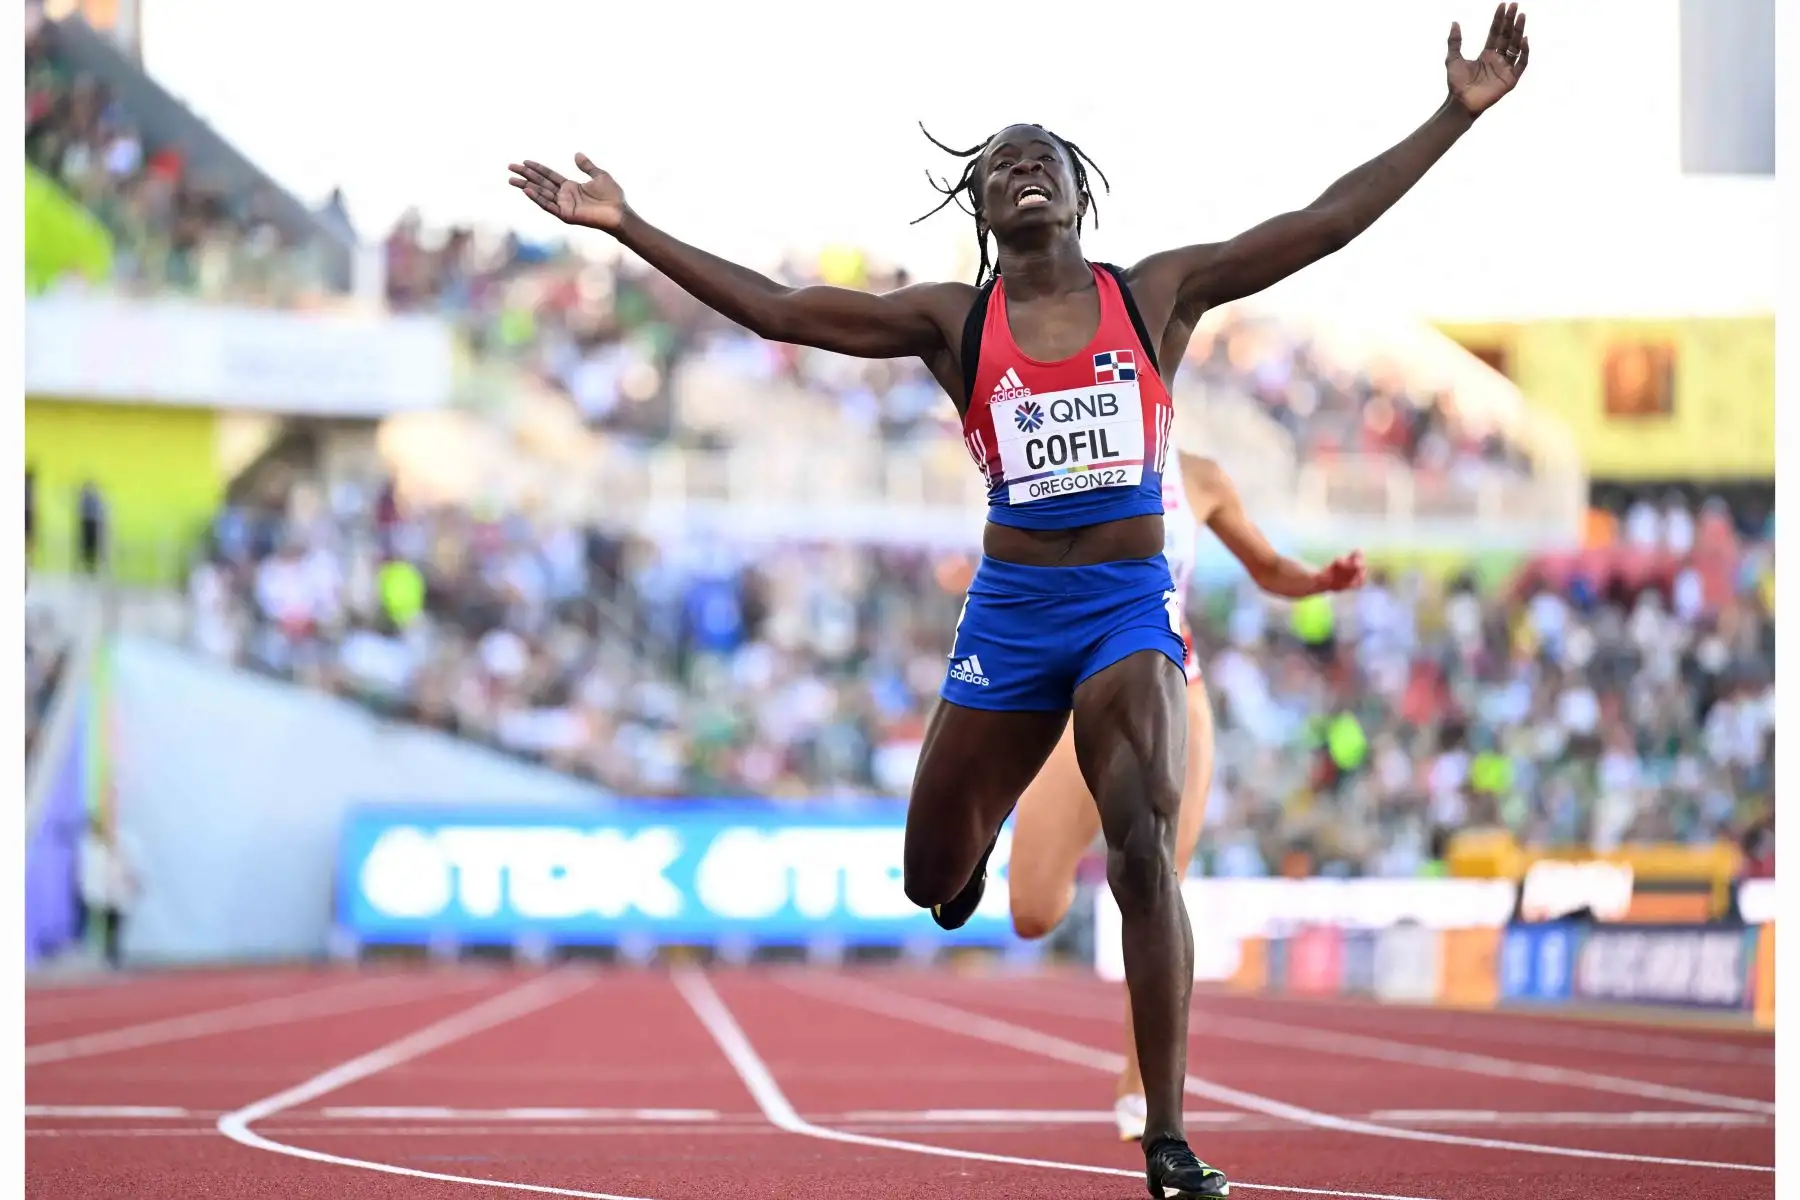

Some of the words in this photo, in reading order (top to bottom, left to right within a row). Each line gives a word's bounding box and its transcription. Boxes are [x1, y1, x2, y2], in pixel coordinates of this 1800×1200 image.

[990, 387, 1031, 404] adidas
[1050, 393, 1119, 423] QNB
[1026, 428, 1119, 470] COFIL
[1029, 470, 1127, 498] OREGON22
[950, 668, 989, 687] adidas
